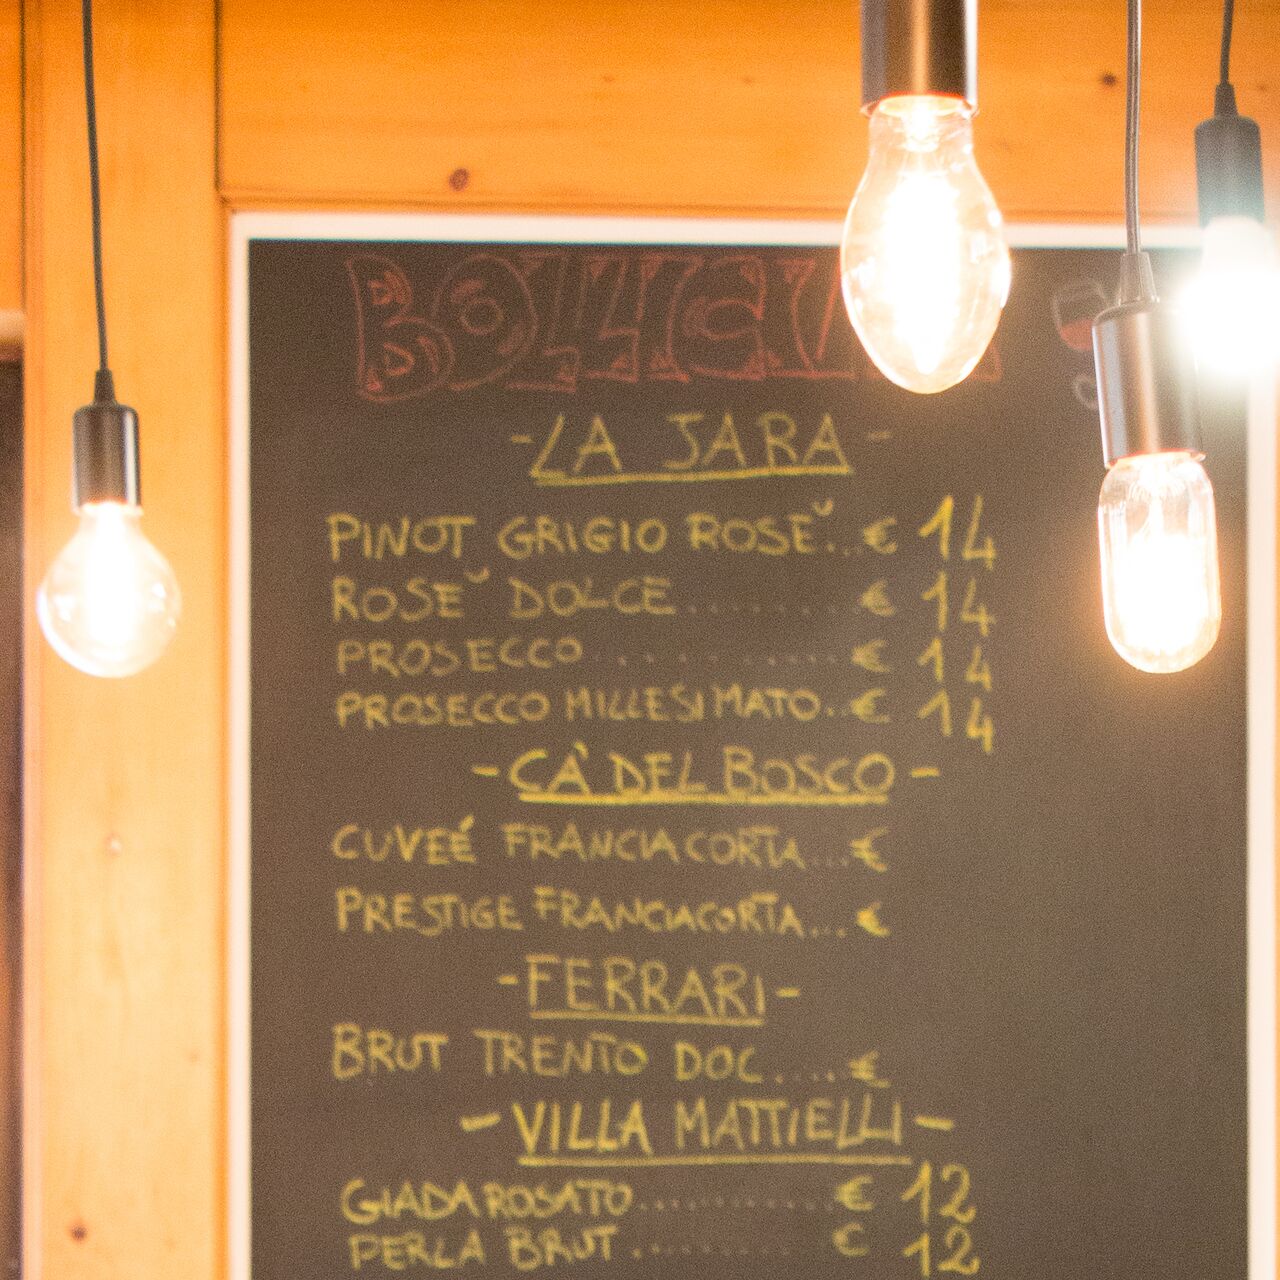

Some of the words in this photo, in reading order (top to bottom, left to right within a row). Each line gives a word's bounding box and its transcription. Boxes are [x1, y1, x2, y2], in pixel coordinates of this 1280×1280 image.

[532, 414, 622, 475] LA
[664, 413, 852, 474] JARA
[326, 512, 476, 562] PINOT
[498, 514, 668, 560] GRIGIO
[918, 495, 997, 570] 14
[508, 575, 679, 619] DOLCE
[920, 570, 997, 638] 14
[336, 636, 585, 679] PROSECCO
[916, 636, 993, 692] 14
[334, 688, 551, 730] PROSECCO
[916, 688, 995, 754] 14
[608, 750, 709, 796] DEL
[724, 745, 897, 796] BOSCO
[501, 822, 806, 870] FRANCIACORTA
[335, 884, 523, 937] PRESTIGE
[533, 884, 805, 938] FRANCIACORTA
[524, 952, 766, 1016] FERRARI
[331, 1021, 449, 1082] BRUT
[473, 1026, 650, 1078] TRENTO
[511, 1098, 652, 1154] VILLA
[673, 1092, 903, 1152] MATTIELLI
[900, 1159, 978, 1226] 12
[348, 1228, 488, 1272] PERLA
[503, 1224, 621, 1272] BRUT
[902, 1222, 982, 1280] 12
